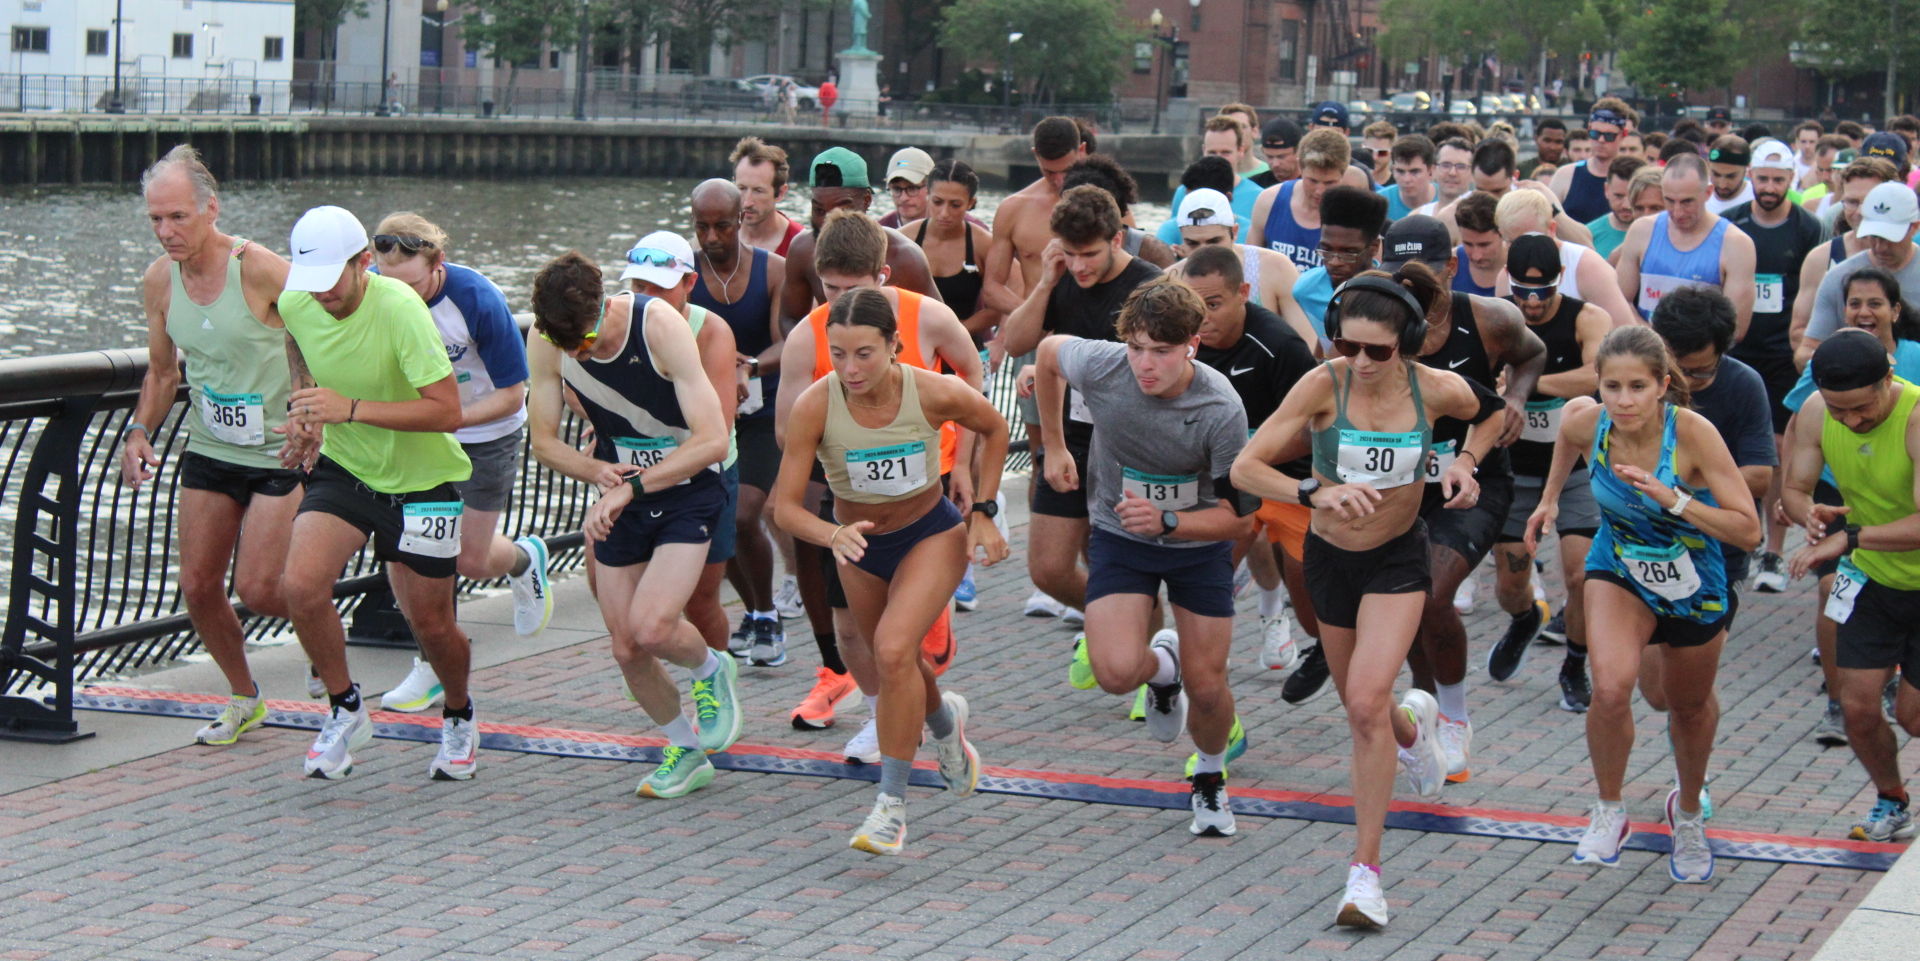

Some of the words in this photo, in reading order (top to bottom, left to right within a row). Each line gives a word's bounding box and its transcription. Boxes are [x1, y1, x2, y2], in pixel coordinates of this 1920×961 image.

[1272, 240, 1295, 257] SHP
[1406, 241, 1422, 251] CLUB
[212, 403, 247, 427] 365
[1527, 411, 1549, 428] 53
[631, 449, 664, 469] 436
[866, 457, 908, 481] 321
[1365, 447, 1395, 473] 30
[1142, 483, 1179, 501] 131
[421, 516, 457, 540] 281
[1638, 561, 1681, 583] 264
